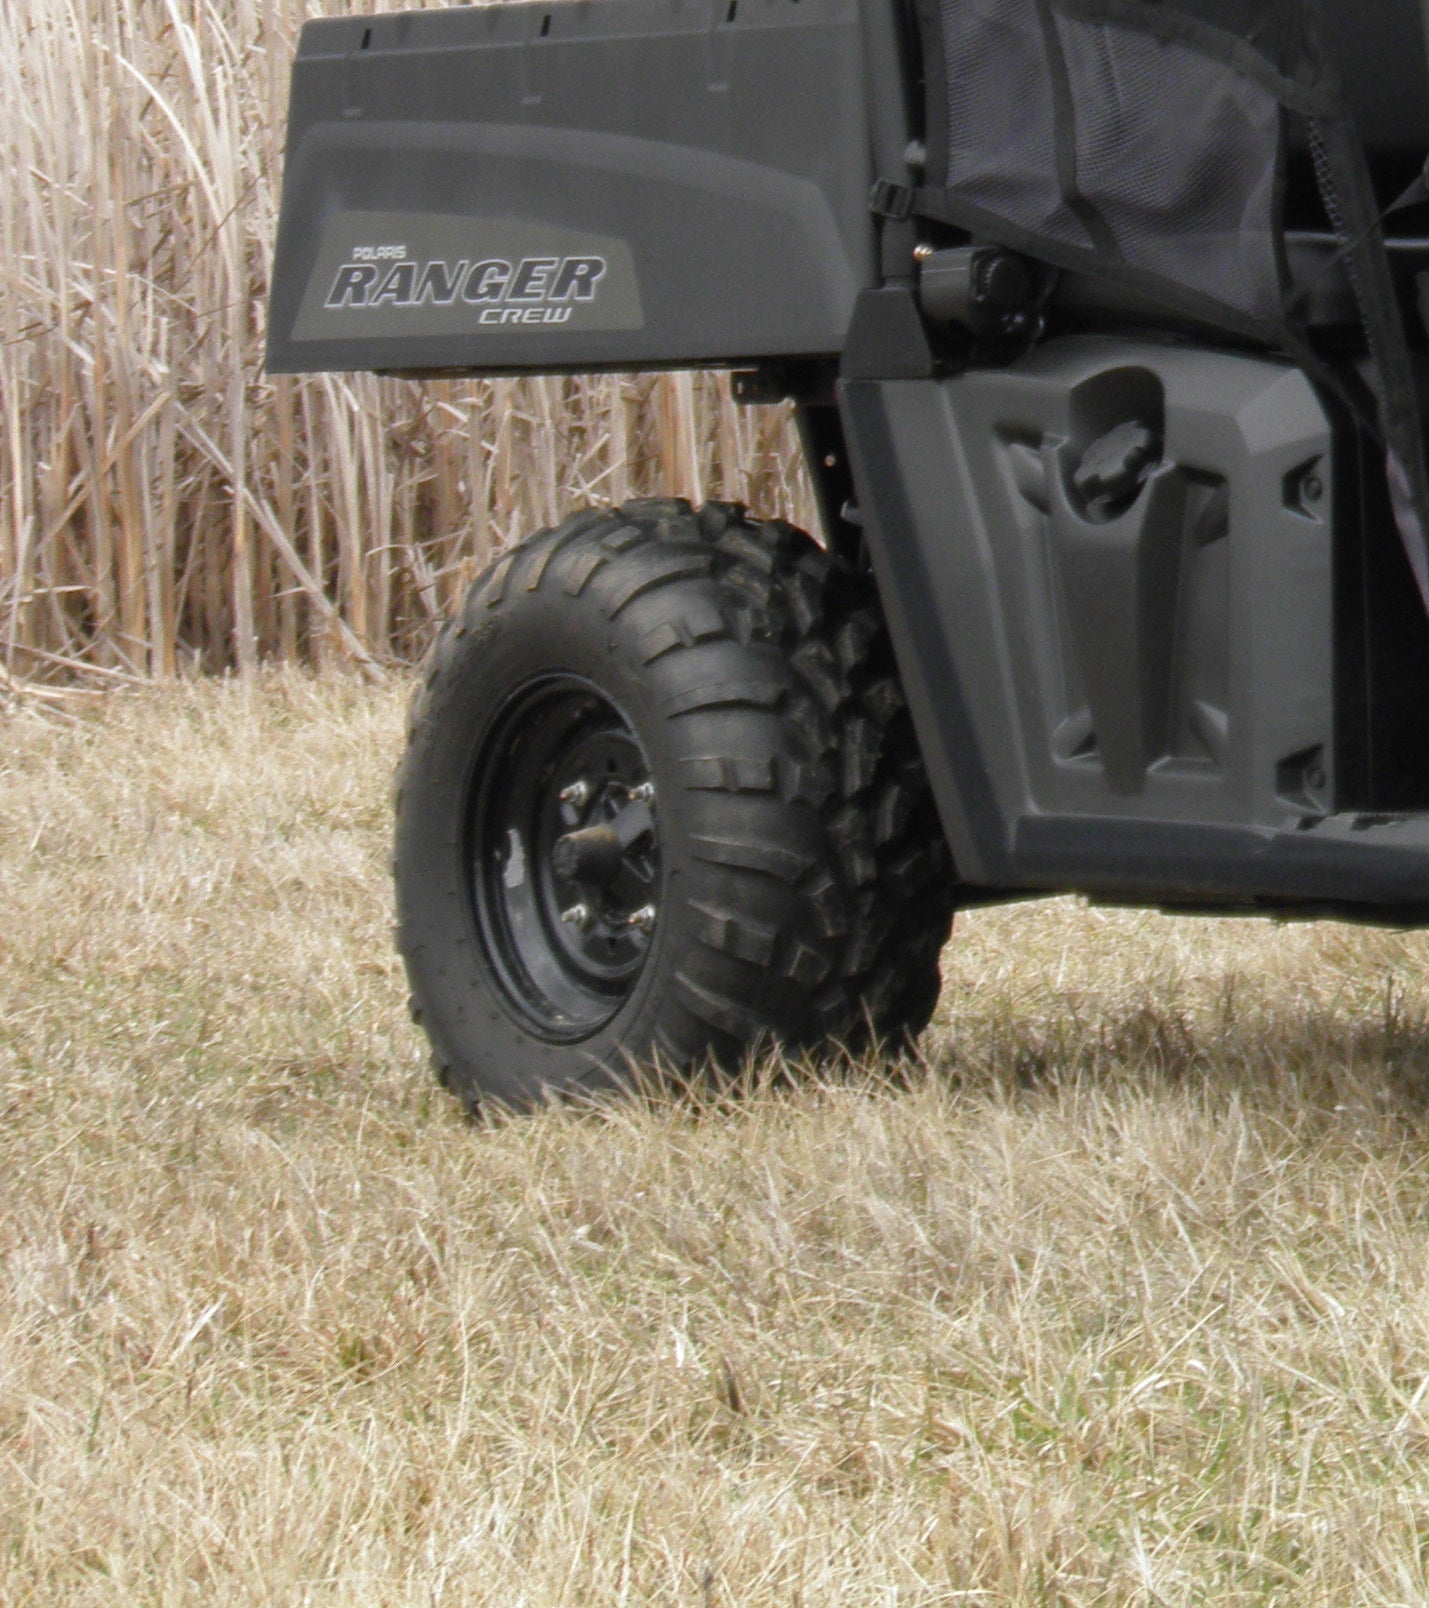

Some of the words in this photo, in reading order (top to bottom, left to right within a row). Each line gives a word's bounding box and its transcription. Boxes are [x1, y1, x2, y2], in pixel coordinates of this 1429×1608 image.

[352, 245, 407, 260] POLARIS
[324, 256, 607, 309] RANGER
[478, 307, 573, 325] CREW
